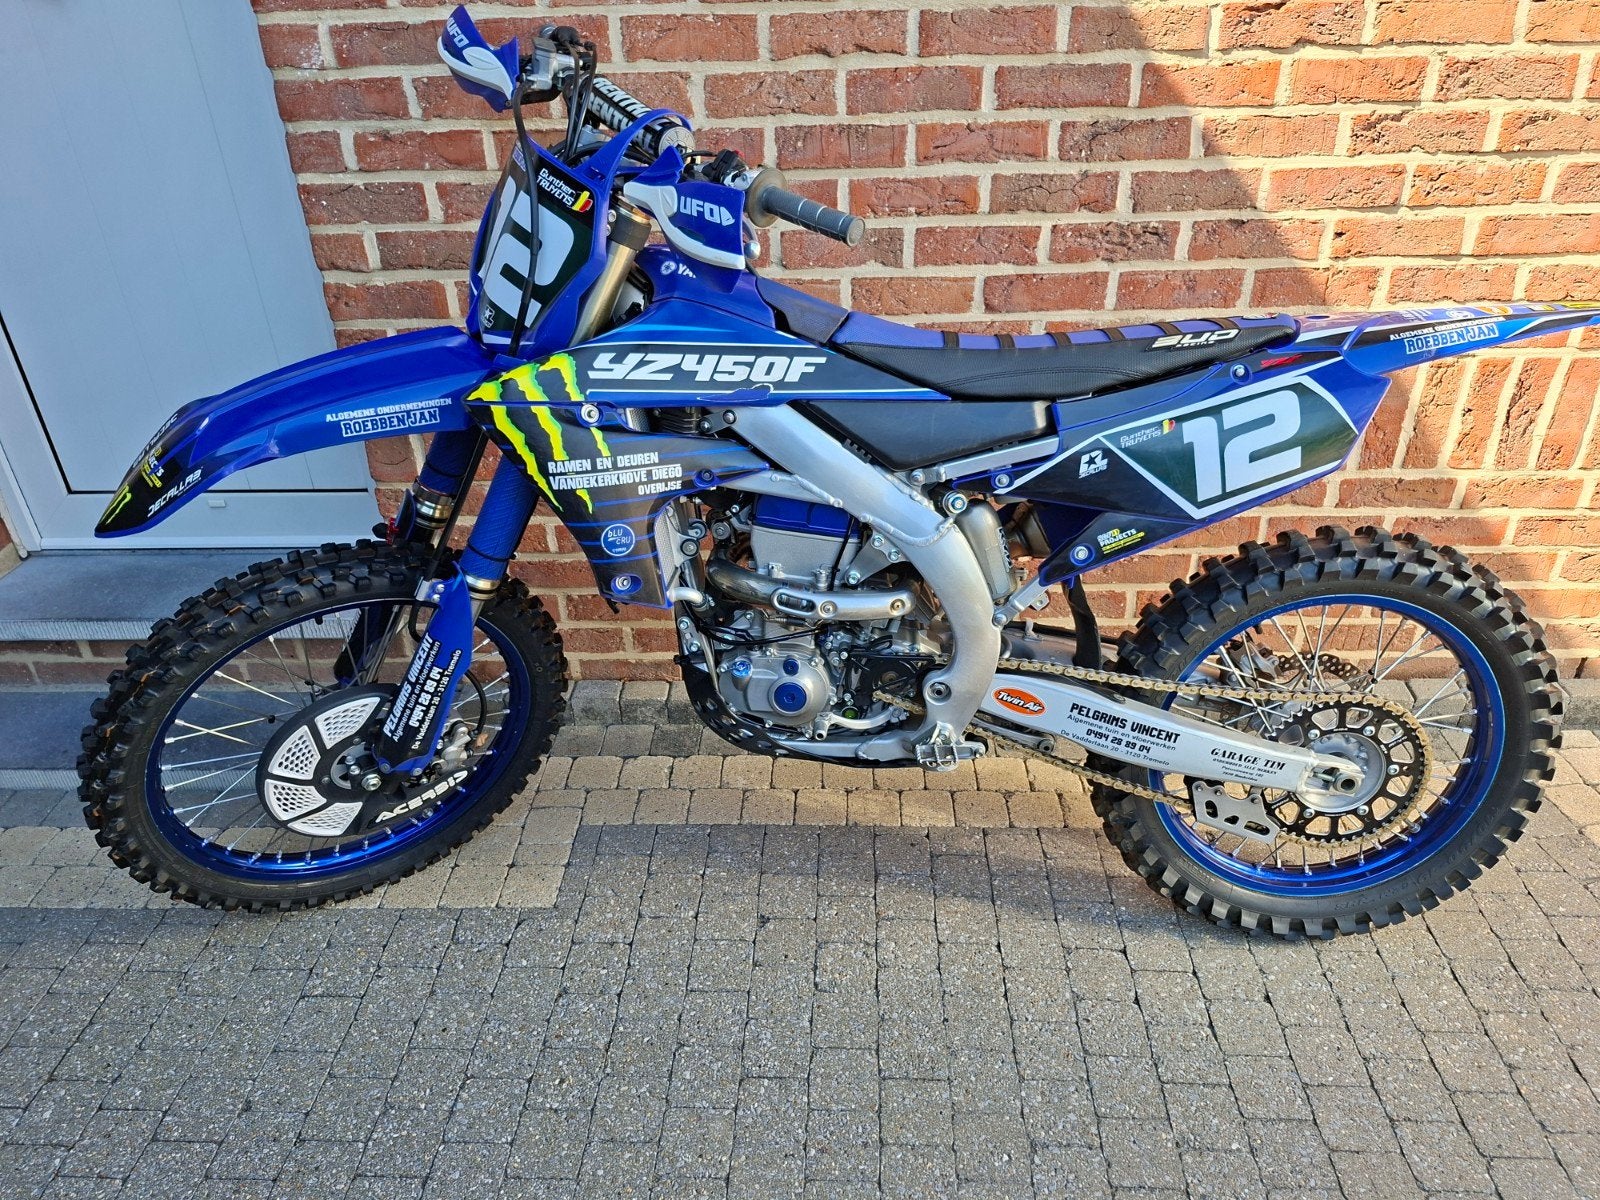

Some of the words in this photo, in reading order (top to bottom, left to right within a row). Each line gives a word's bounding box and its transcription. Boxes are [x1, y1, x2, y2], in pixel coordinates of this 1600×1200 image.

[447, 17, 470, 48] UFO
[592, 77, 671, 131] RENTHL
[536, 175, 575, 206] TRUYENS
[539, 167, 577, 198] Gunther
[680, 196, 721, 224] UFO
[1406, 328, 1467, 354] ROEBBEN
[1467, 323, 1499, 343] JAN
[587, 352, 827, 382] YZ450F
[325, 407, 376, 423] ALGEMENE
[342, 413, 408, 437] ROEBBEN
[408, 408, 440, 428] JAN
[1183, 390, 1302, 503] 12
[547, 459, 592, 474] RAMEN
[596, 457, 613, 470] EN
[617, 452, 659, 468] DEUREN
[549, 471, 648, 491] VANDEKERKHOVE
[652, 466, 683, 480] DIEGO
[638, 480, 682, 496] OVERIJSE
[383, 681, 412, 738] PELGRIMS
[407, 632, 433, 683] VINCENT
[430, 666, 443, 680] 04
[437, 676, 450, 692] 3120
[444, 649, 462, 676] Tremelo
[418, 692, 431, 706] 28
[424, 680, 437, 693] 89
[997, 691, 1025, 706] Twin
[1023, 702, 1043, 712] Air
[393, 708, 411, 742] Algemene
[407, 691, 417, 708] tuin
[409, 704, 426, 728] 0494
[1069, 702, 1128, 729] PELGRIMS
[1130, 720, 1181, 744] VINCENT
[1060, 729, 1070, 737] De
[1072, 732, 1109, 749] Vadderlaan
[1124, 750, 1141, 758] 3120
[1143, 754, 1170, 766] Tremelo
[1067, 714, 1103, 731] Algemene
[1105, 726, 1119, 735] tuin
[1132, 734, 1176, 751] vloerwerken
[1086, 728, 1110, 742] 0494
[1111, 736, 1123, 746] 28
[1125, 740, 1137, 750] 89
[1138, 744, 1151, 754] 04
[1210, 747, 1261, 766] GARAGE
[1263, 759, 1286, 770] TIM
[375, 770, 468, 823] ACERBIS
